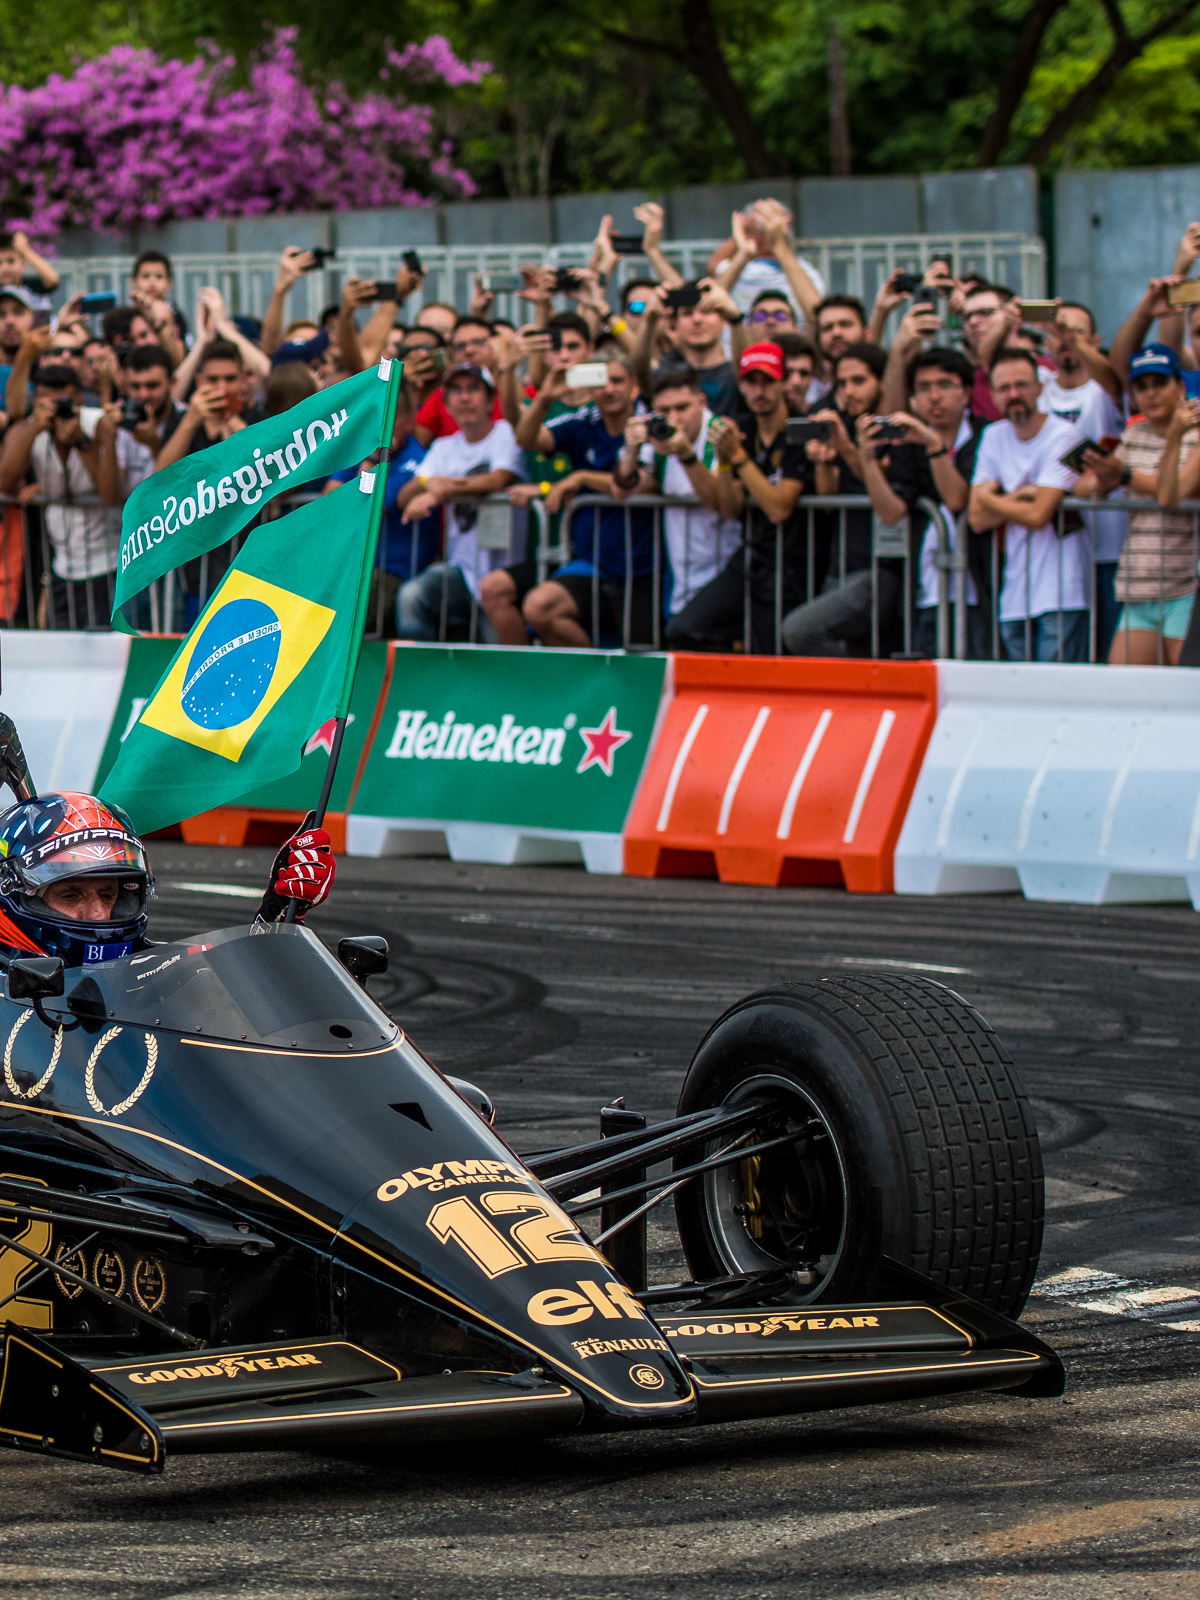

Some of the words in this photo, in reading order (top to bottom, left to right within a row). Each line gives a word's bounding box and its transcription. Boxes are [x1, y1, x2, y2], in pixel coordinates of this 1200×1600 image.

[384, 709, 568, 766] Heineken
[296, 834, 314, 847] OMP
[87, 945, 105, 960] BI
[747, 1016, 815, 1055] AVON
[376, 1159, 536, 1202] OLYMPU
[427, 1173, 532, 1192] CAMERAS
[425, 1190, 615, 1280] 12
[526, 1280, 647, 1326] elf
[570, 1337, 600, 1348] Turbo
[574, 1338, 671, 1360] RENAULT
[128, 1353, 322, 1385] GOODYEAR
